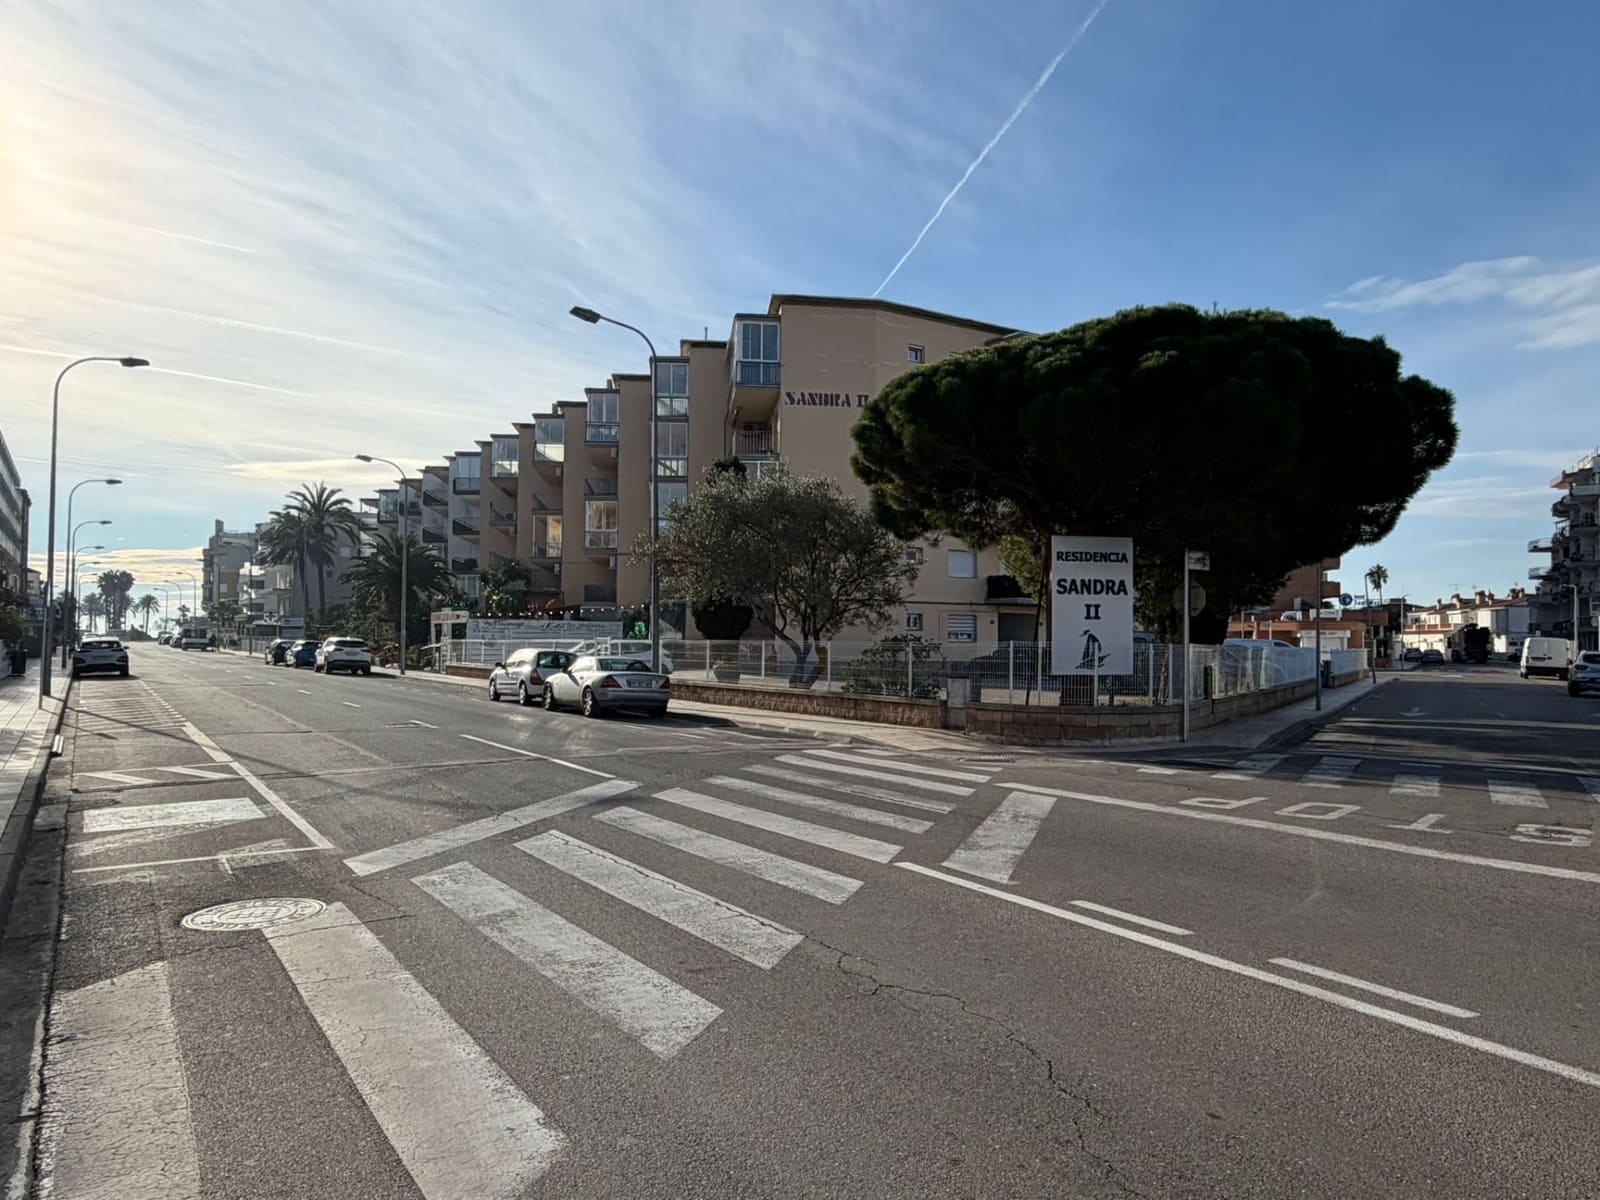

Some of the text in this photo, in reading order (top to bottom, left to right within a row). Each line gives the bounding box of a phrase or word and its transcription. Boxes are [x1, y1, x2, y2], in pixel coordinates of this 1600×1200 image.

[785, 391, 851, 408] SANDRA
[1056, 551, 1128, 563] RESIDENCIA
[1056, 578, 1128, 595] SANDRA
[1084, 604, 1101, 620] II
